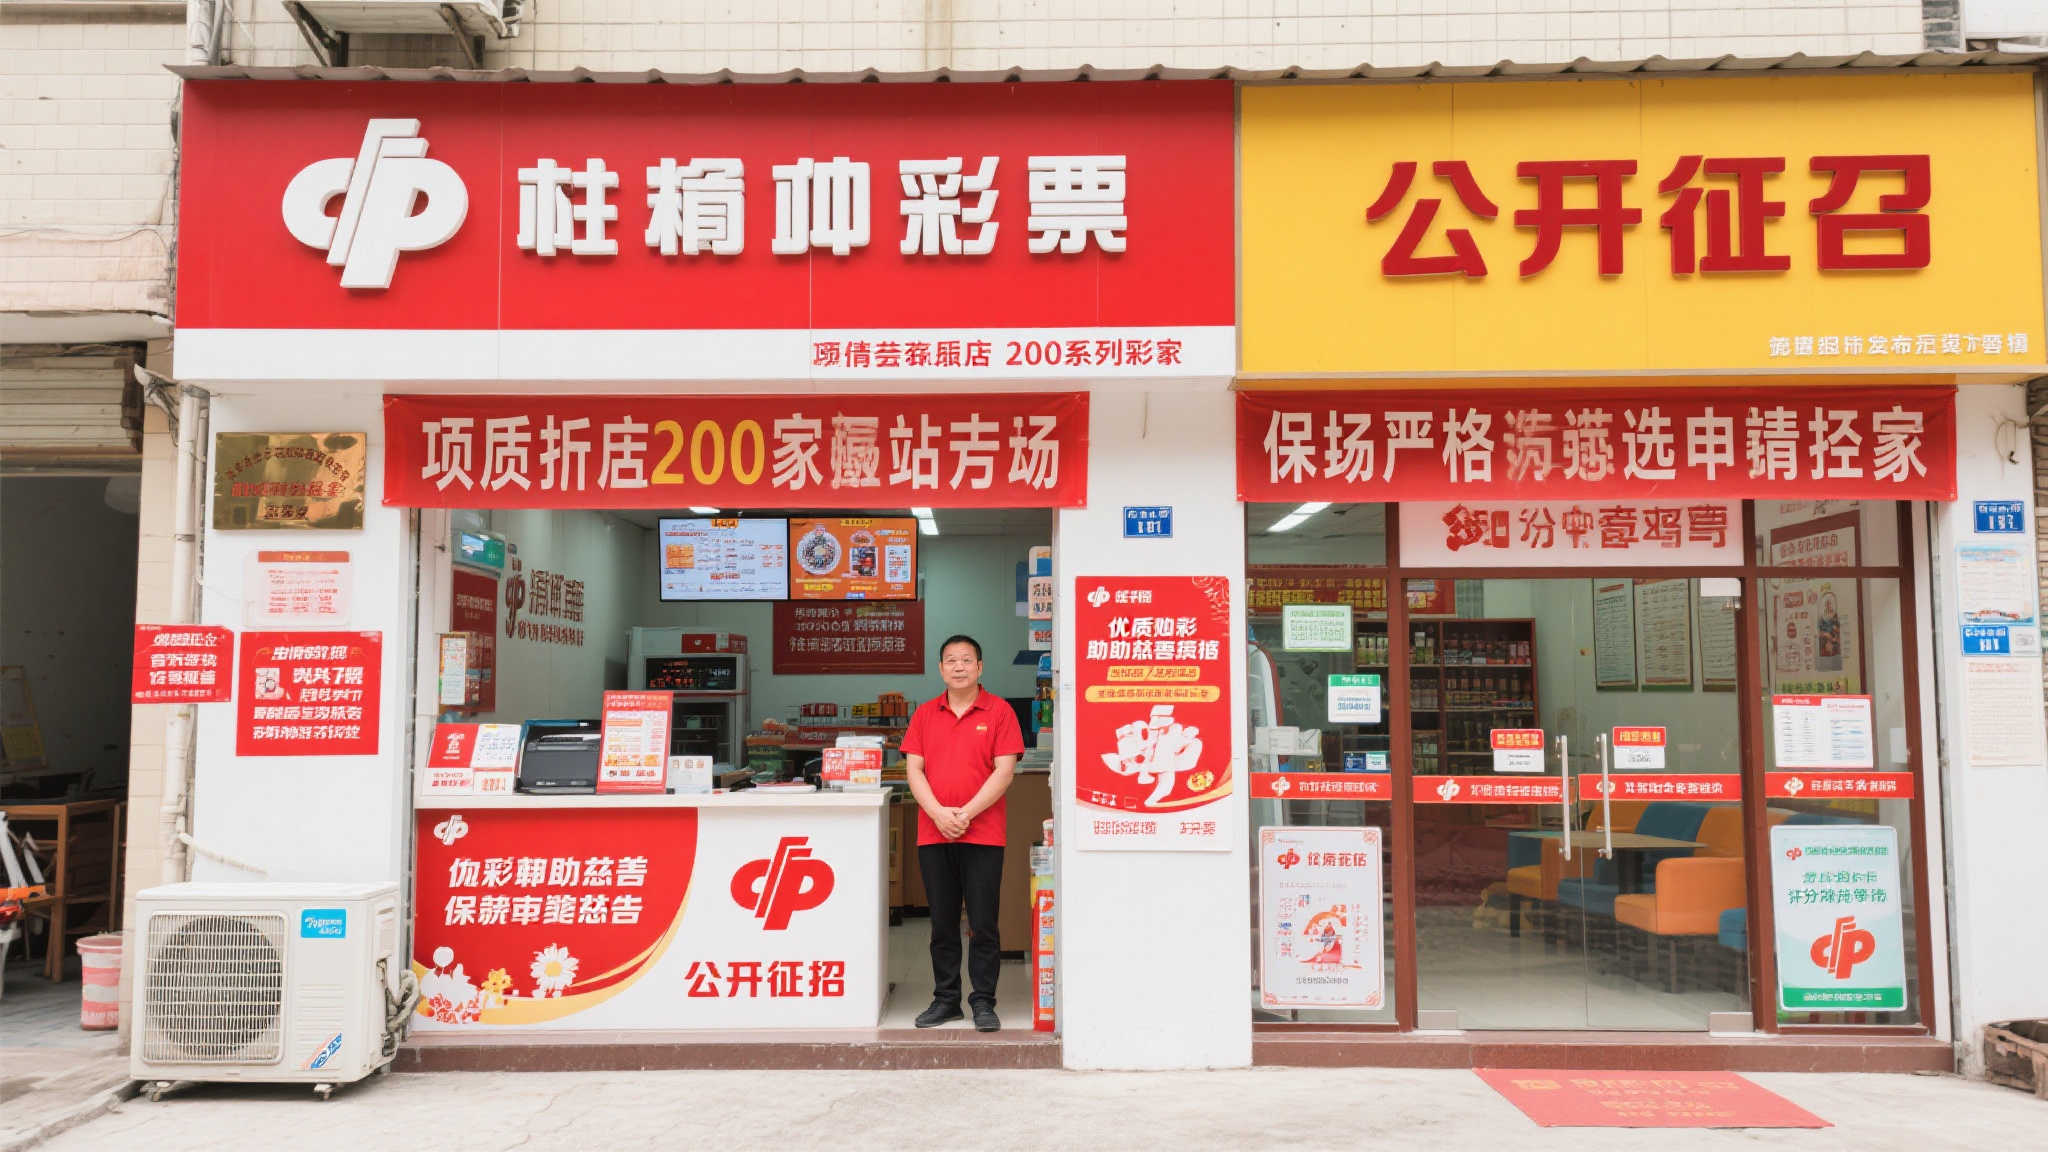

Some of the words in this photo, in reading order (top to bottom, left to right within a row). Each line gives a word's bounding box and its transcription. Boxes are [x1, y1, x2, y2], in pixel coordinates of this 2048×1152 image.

[1366, 154, 1931, 282] 公开征召
[684, 960, 846, 998] 公开征招
